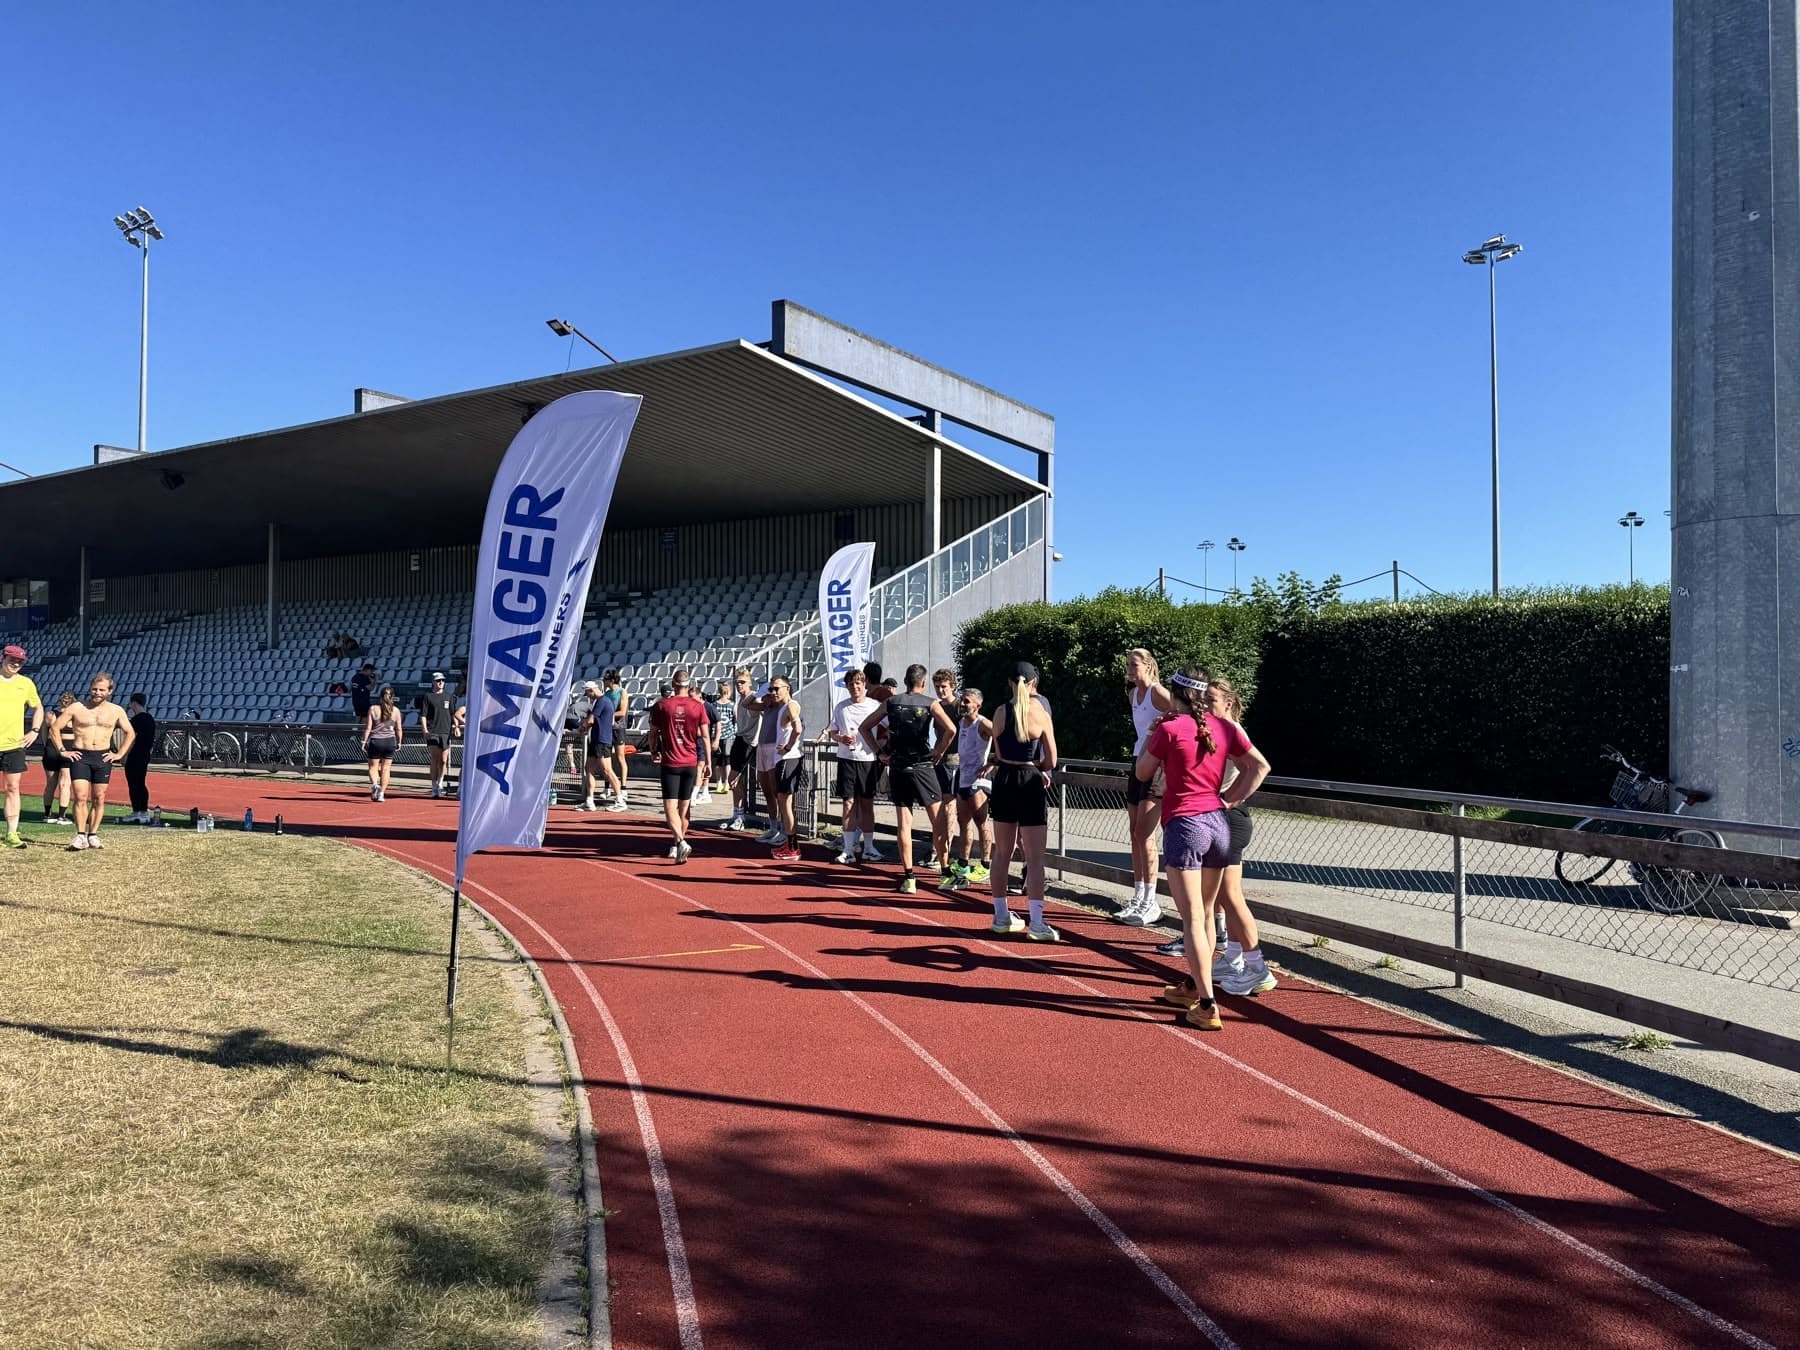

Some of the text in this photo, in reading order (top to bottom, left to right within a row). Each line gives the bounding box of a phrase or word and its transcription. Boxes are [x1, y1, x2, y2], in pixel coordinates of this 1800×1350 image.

[410, 554, 420, 571] E
[476, 483, 566, 796] AMAGER
[537, 592, 572, 701] RUNNERS
